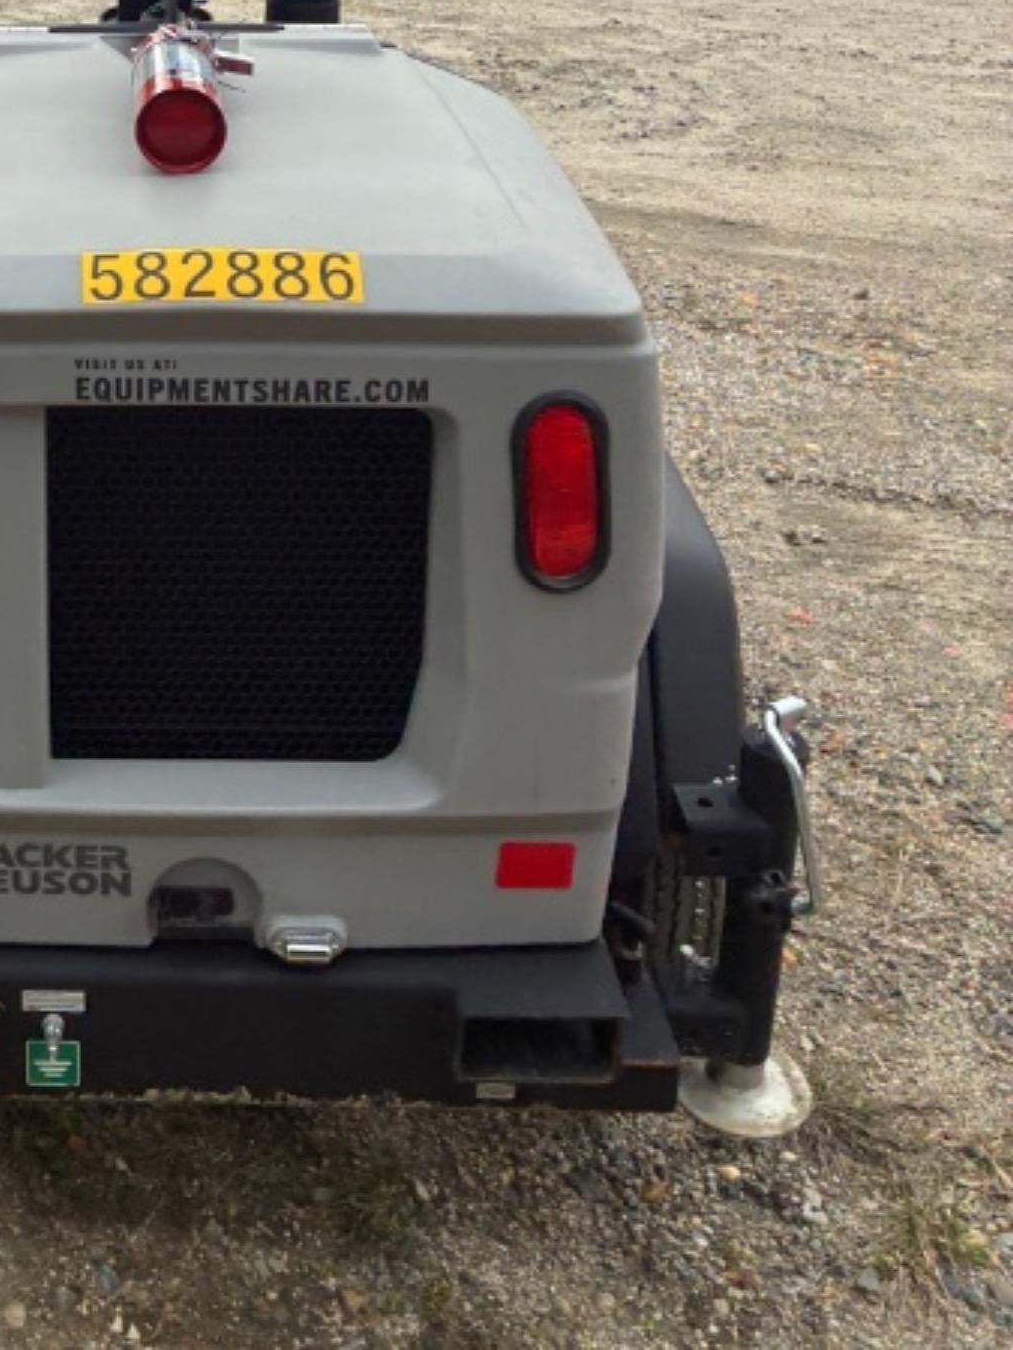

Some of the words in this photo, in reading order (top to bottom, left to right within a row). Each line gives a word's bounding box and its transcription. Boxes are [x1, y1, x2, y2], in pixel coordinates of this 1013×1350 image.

[89, 250, 355, 301] 582886
[74, 358, 116, 371] VISIT
[124, 358, 145, 371] US
[75, 377, 430, 404] EQUIPMENTSHARE.COM
